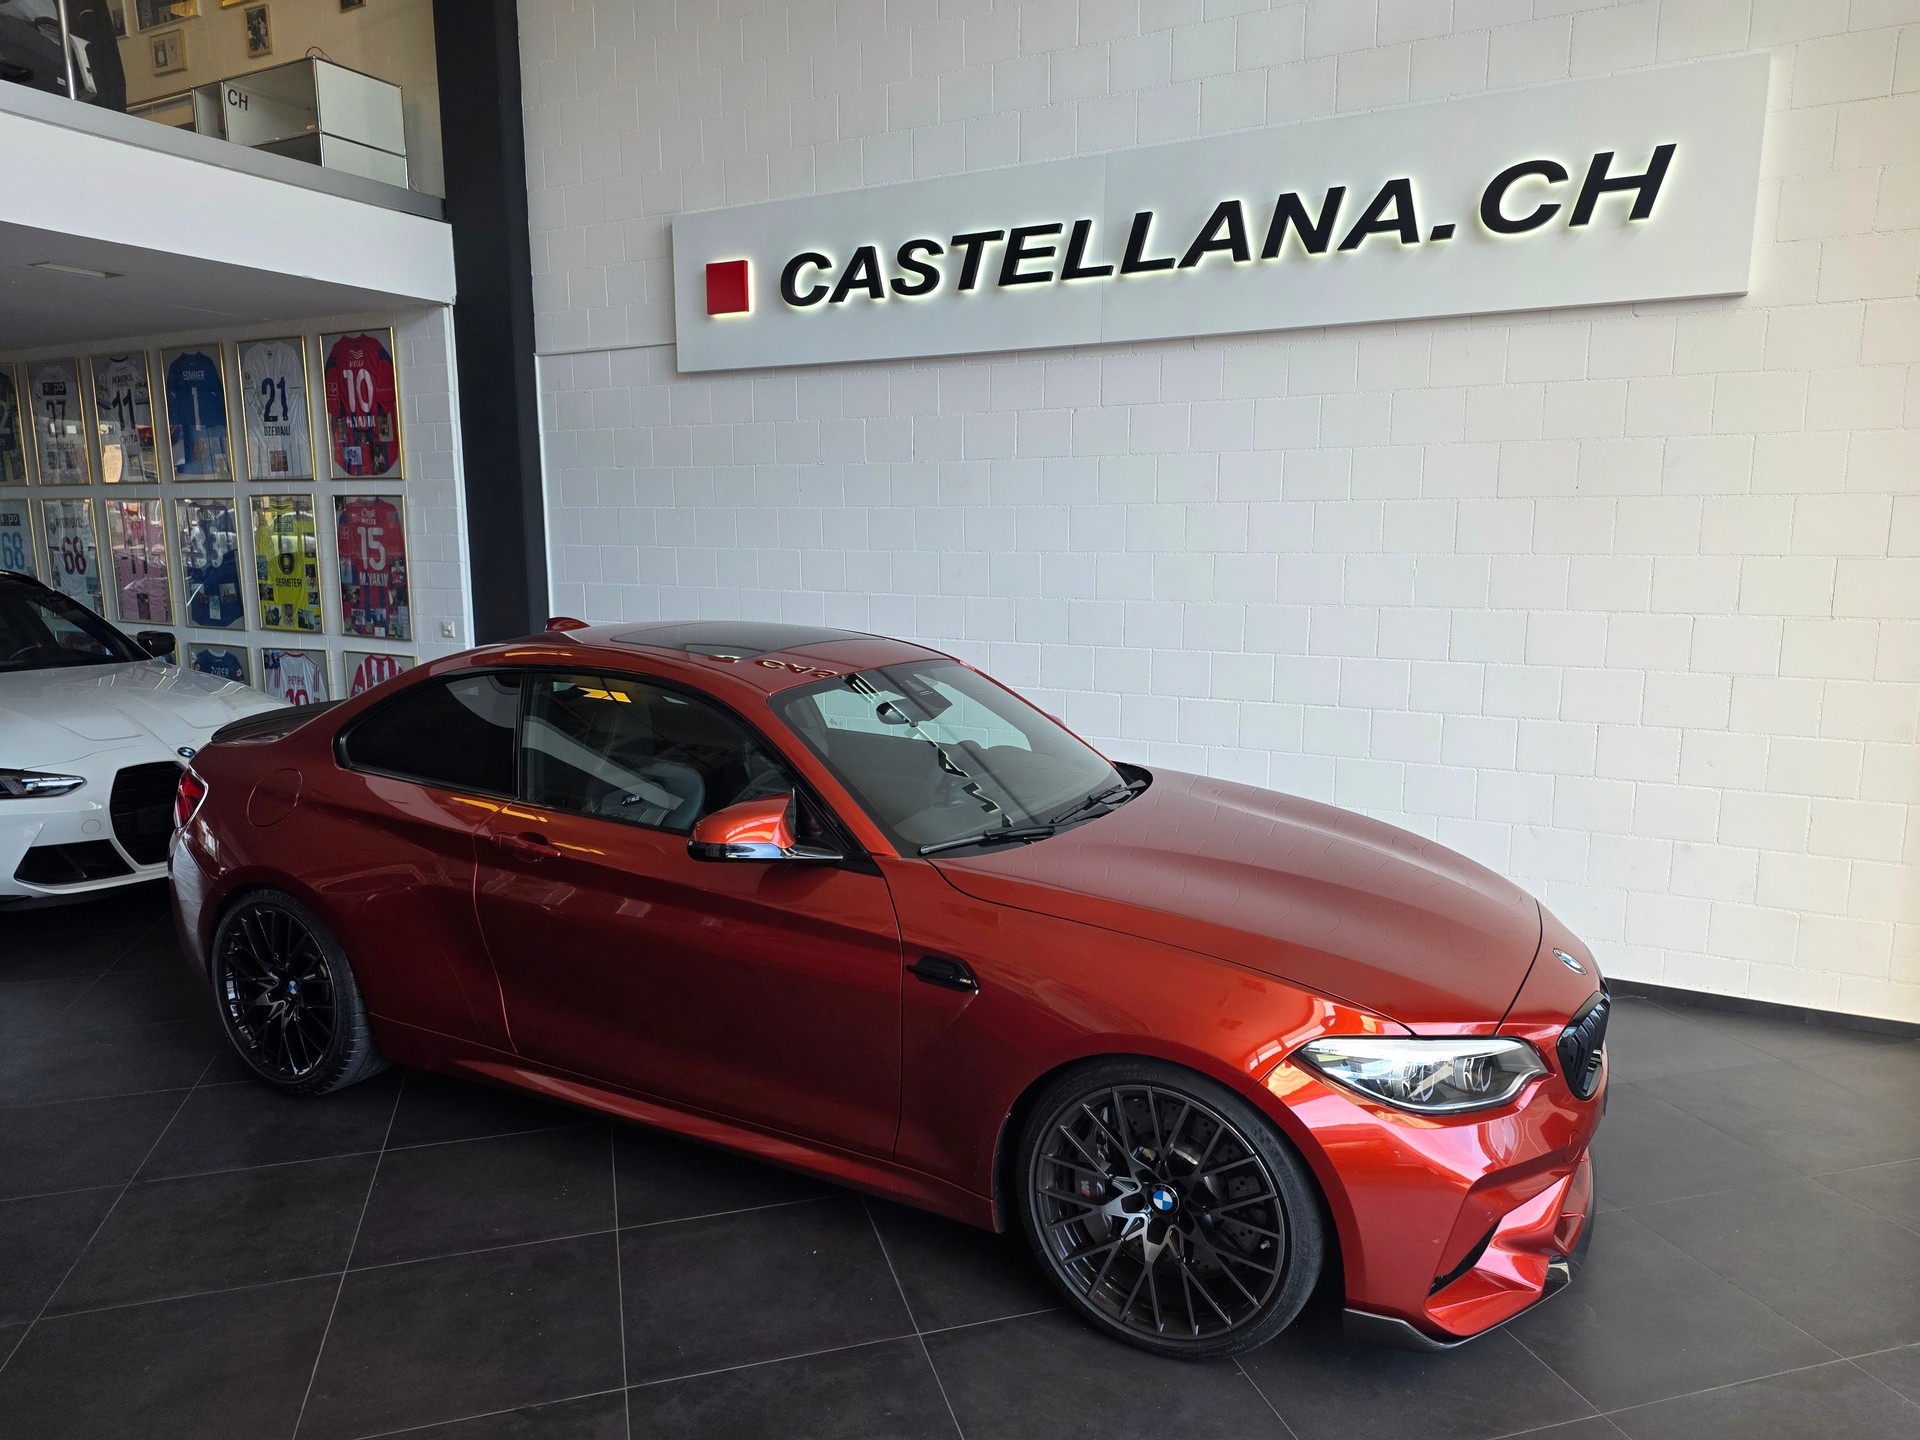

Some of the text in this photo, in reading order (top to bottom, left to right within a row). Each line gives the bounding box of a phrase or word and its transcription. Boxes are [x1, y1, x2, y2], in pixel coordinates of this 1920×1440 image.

[228, 88, 248, 111] CH
[780, 143, 1676, 308] CASTELLANA.CH
[112, 388, 136, 431] 11
[191, 386, 202, 431] 1
[261, 376, 289, 422] 21
[343, 369, 374, 413] 10
[2, 532, 25, 570] 68
[62, 536, 87, 575] 68
[357, 526, 387, 571] 15
